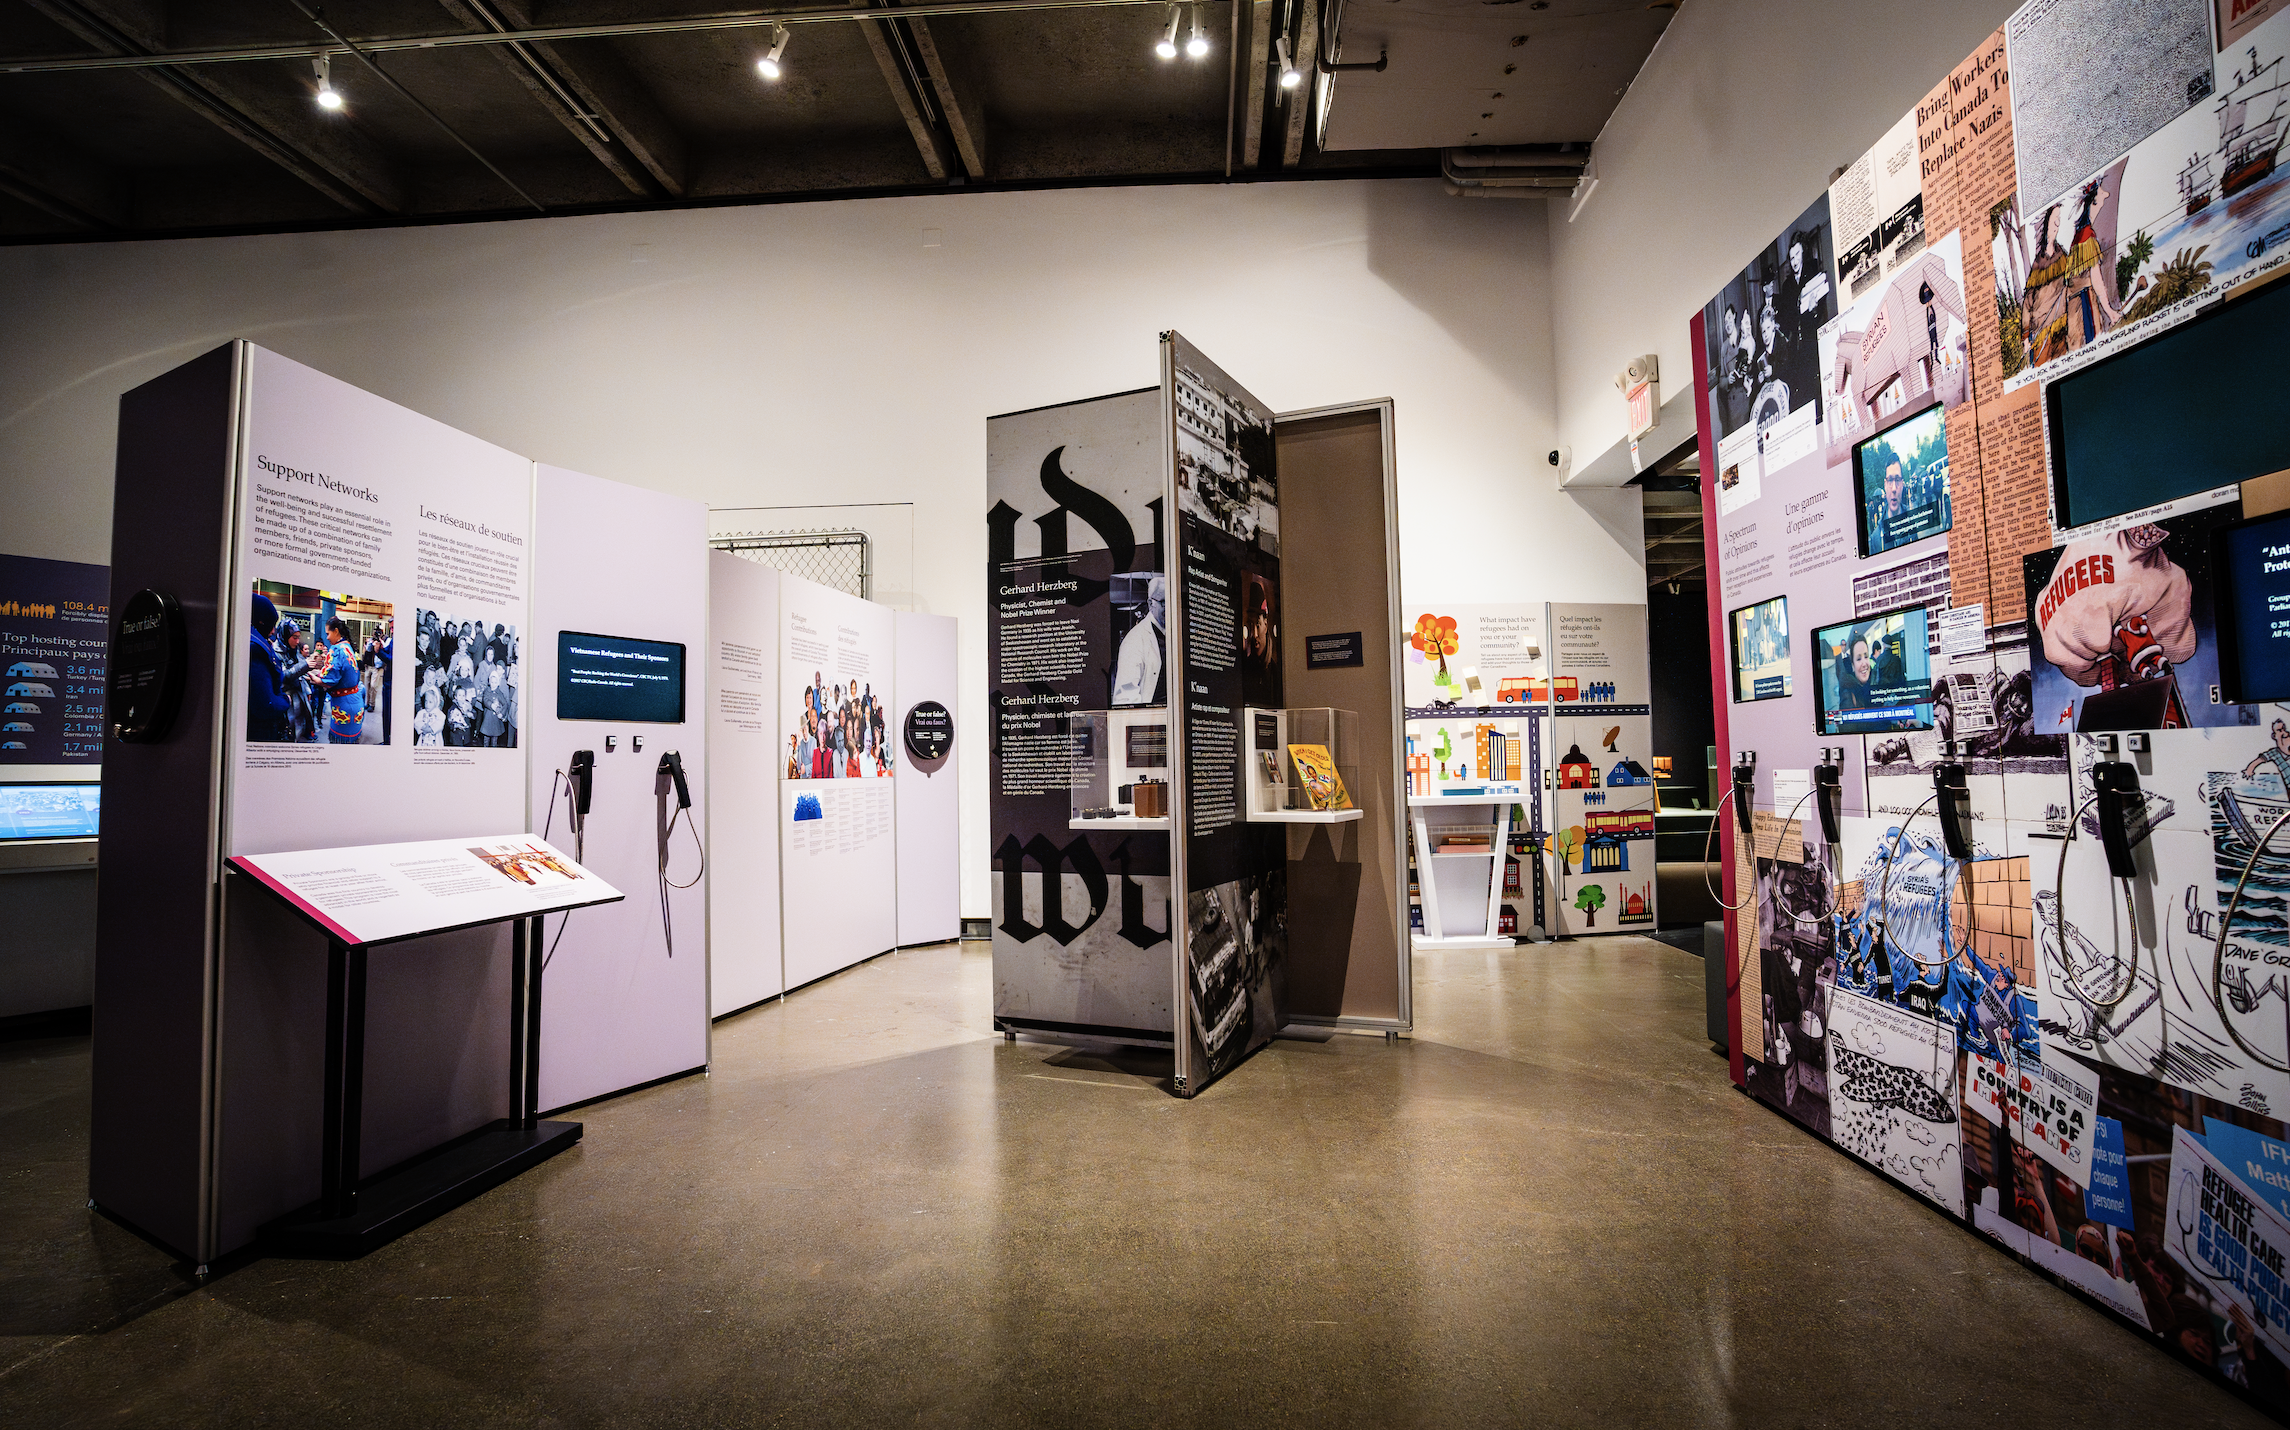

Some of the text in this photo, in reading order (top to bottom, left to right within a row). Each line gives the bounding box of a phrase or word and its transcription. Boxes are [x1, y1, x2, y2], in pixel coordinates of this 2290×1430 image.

[1916, 43, 2005, 128] Bring Workers
[1919, 68, 2009, 154] Into Canada To
[1921, 136, 1966, 180] Replace
[1968, 104, 2003, 144] Nazis
[2022, 373, 2036, 384] YOU
[2036, 367, 2048, 378] ASK
[2061, 355, 2074, 364] THIS
[2075, 345, 2097, 359] HUMAN
[2097, 323, 2141, 349] SMUGGLING
[2142, 308, 2172, 327] RACKET
[2173, 303, 2181, 313] IS
[2182, 286, 2219, 308] GETTING
[2221, 275, 2242, 290] OUT
[2243, 268, 2258, 280] OF
[1630, 390, 1648, 433] EXIT
[257, 454, 379, 504] Support Networks
[256, 483, 286, 499] Support
[287, 493, 319, 508] networks
[320, 502, 334, 513] play
[344, 509, 372, 522] essential
[372, 517, 384, 526] role
[384, 519, 391, 527] in
[1784, 489, 1829, 516] Une gamme
[255, 505, 383, 543] of refugees. These critical networks can
[256, 495, 393, 537] the well-being and successful resettlement
[1786, 511, 1825, 535] d'opinions
[2048, 508, 2054, 523] 4
[255, 515, 265, 523] be
[266, 518, 287, 529] made
[288, 524, 298, 532] up
[299, 525, 307, 534] of
[313, 530, 354, 546] combination
[354, 540, 361, 548] of
[362, 541, 381, 553] family
[420, 504, 523, 546] Les réseaux de soutien
[1723, 522, 1757, 545] A Spectrum
[1724, 539, 1758, 561] of Opinions
[1000, 579, 1078, 596] Gerhard Herzberg
[2039, 554, 2115, 632] REFUGEES
[63, 601, 95, 611] 108.4
[1000, 597, 1067, 611] Physicist, Chemist and
[1000, 608, 1056, 619] Nobel Prize Winner
[1497, 616, 1520, 625] impact
[1520, 615, 1537, 623] have
[1559, 615, 1574, 623] Quel
[1574, 615, 1594, 624] impact
[1479, 624, 1507, 634] refugees
[1560, 624, 1582, 633] réfugiés
[2, 632, 77, 649] Top hosting
[1479, 634, 1493, 642] you
[1501, 634, 1517, 642] your
[1479, 641, 1520, 650] community?
[1, 644, 101, 662] Principaux pays
[569, 646, 601, 656] Vietnamese
[600, 649, 624, 659] Refugees
[633, 652, 648, 660] Their
[647, 654, 669, 662] Sponsors
[66, 665, 86, 675] 3.6
[66, 684, 85, 694] 3.4
[2211, 686, 2219, 703] 5
[1001, 692, 1080, 706] Gerhard Herzberg
[65, 704, 84, 713] 2.5
[1001, 711, 1064, 722] Physicien, chimiste et
[64, 722, 81, 732] 2.1
[1001, 720, 1041, 731] du prix Nobel
[63, 742, 81, 751] 1.7
[2130, 739, 2138, 747] FR
[1936, 769, 1942, 779] 3
[2098, 771, 2104, 781] 4
[1907, 874, 1930, 884] SYRIA'S
[1903, 882, 1937, 897] REFUGEES
[2224, 943, 2260, 961] DAVE
[1910, 993, 1927, 1011] IRAQ
[1977, 1066, 2080, 1142] COUNTRY OF
[2050, 1094, 2067, 1117] IS
[2069, 1109, 2085, 1130] A
[1973, 1078, 2082, 1164] IMMGRANTS
[2107, 1147, 2124, 1166] pour
[2093, 1168, 2119, 1190] chaque
[2091, 1193, 2126, 1214] personne!
[2202, 1163, 2256, 1228] REFUGEE
[2198, 1209, 2212, 1239] IS
[2214, 1223, 2248, 1271] GOOD
[2200, 1186, 2286, 1280] HEALTH CARE
[2197, 1232, 2246, 1294] HEALTH
